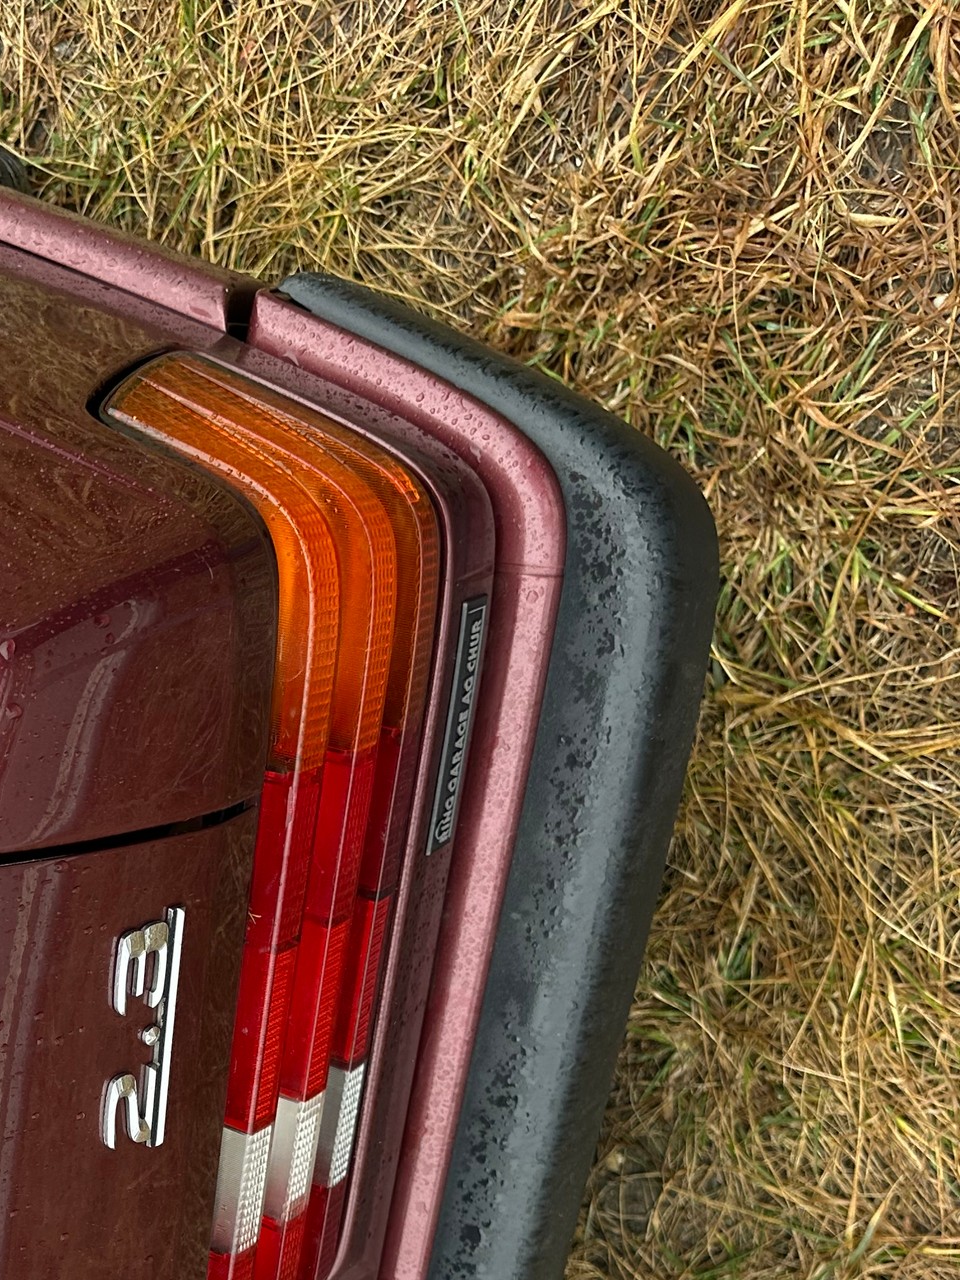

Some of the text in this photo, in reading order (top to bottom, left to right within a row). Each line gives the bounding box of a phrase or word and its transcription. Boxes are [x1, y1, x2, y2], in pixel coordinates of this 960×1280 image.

[438, 619, 482, 843] RING GARAGE AG CHUR
[99, 920, 169, 1150] 2.3
